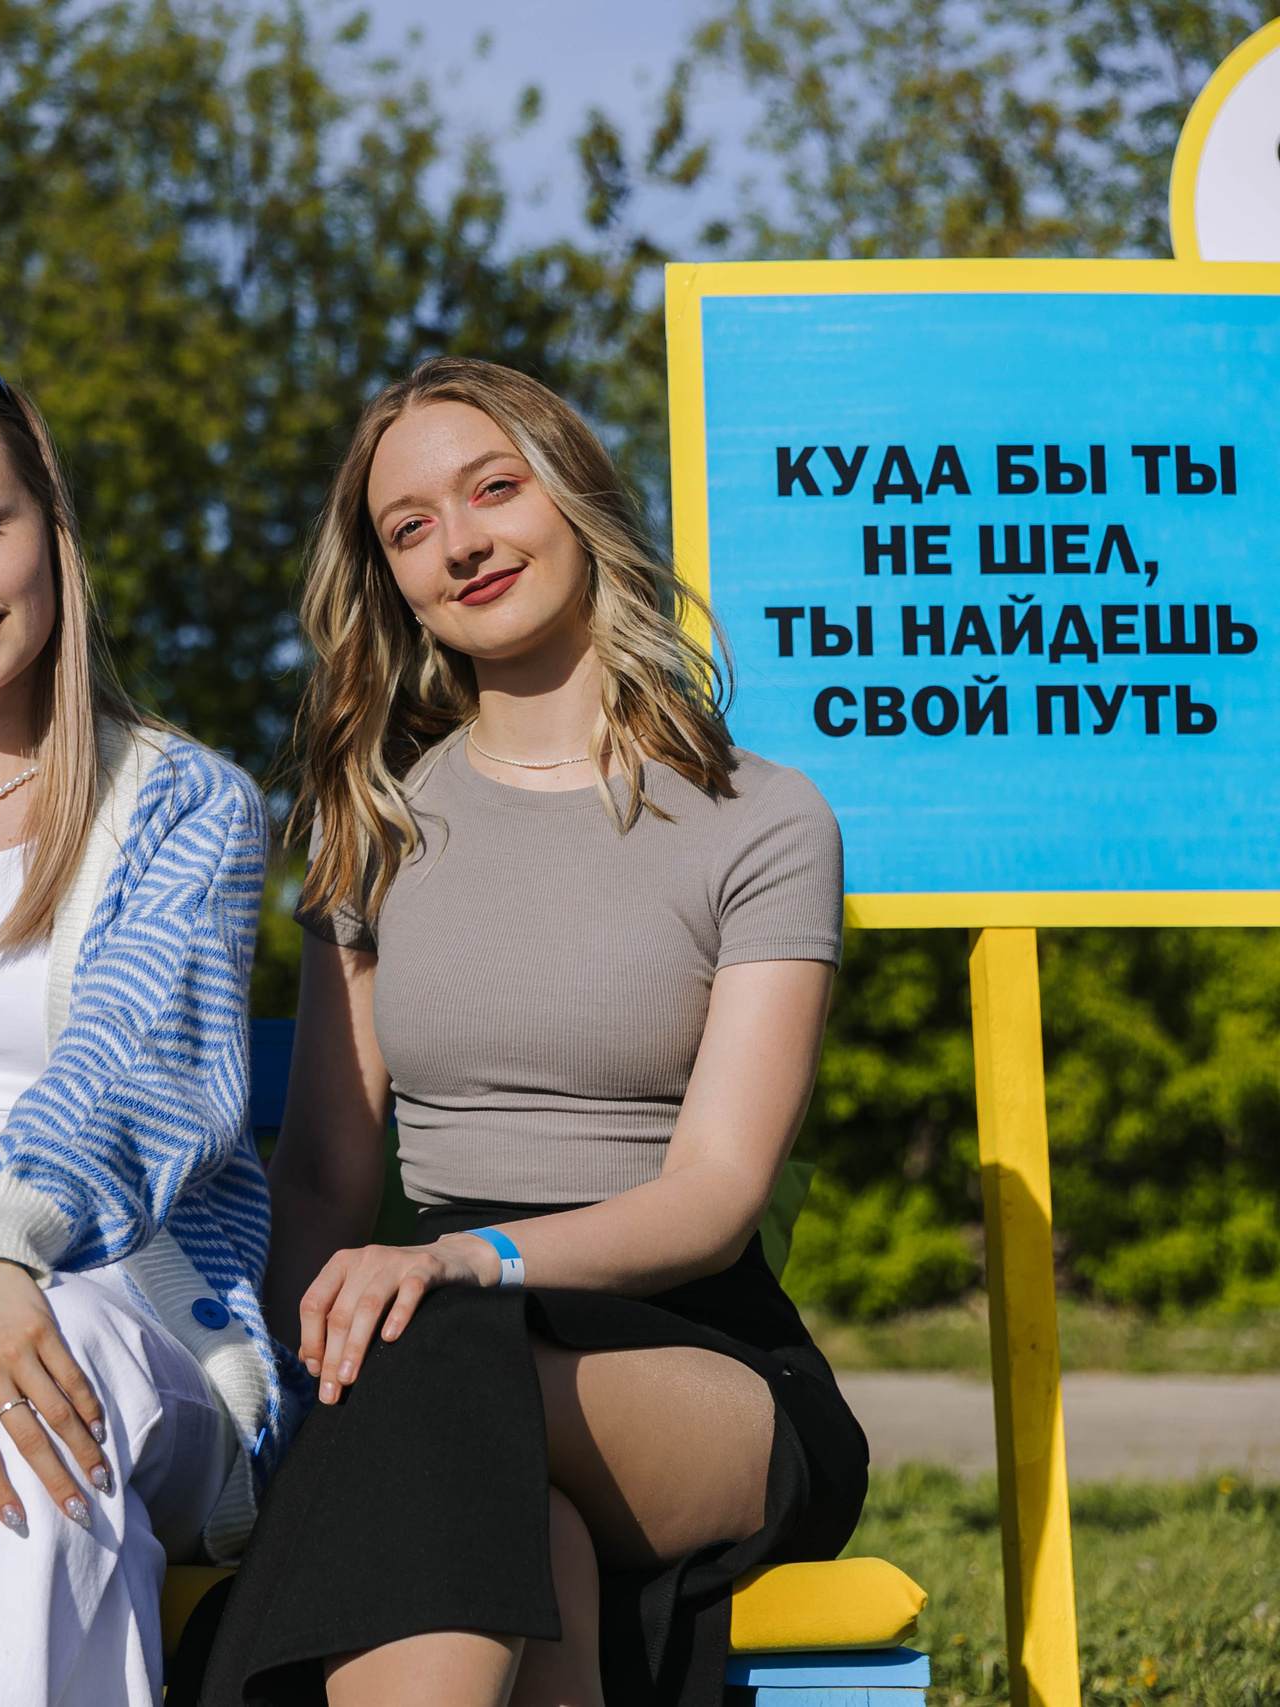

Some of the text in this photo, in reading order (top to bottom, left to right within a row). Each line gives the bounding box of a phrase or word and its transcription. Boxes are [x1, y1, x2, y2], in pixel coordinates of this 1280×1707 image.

[776, 444, 1237, 505] КУДА БЫ ТЫ
[862, 524, 1159, 588] НЕ ШЕЛ,
[764, 593, 1259, 664] ТЫ НАЙДЕШЬ
[813, 674, 1218, 738] СВОЙ ПУТЬ
